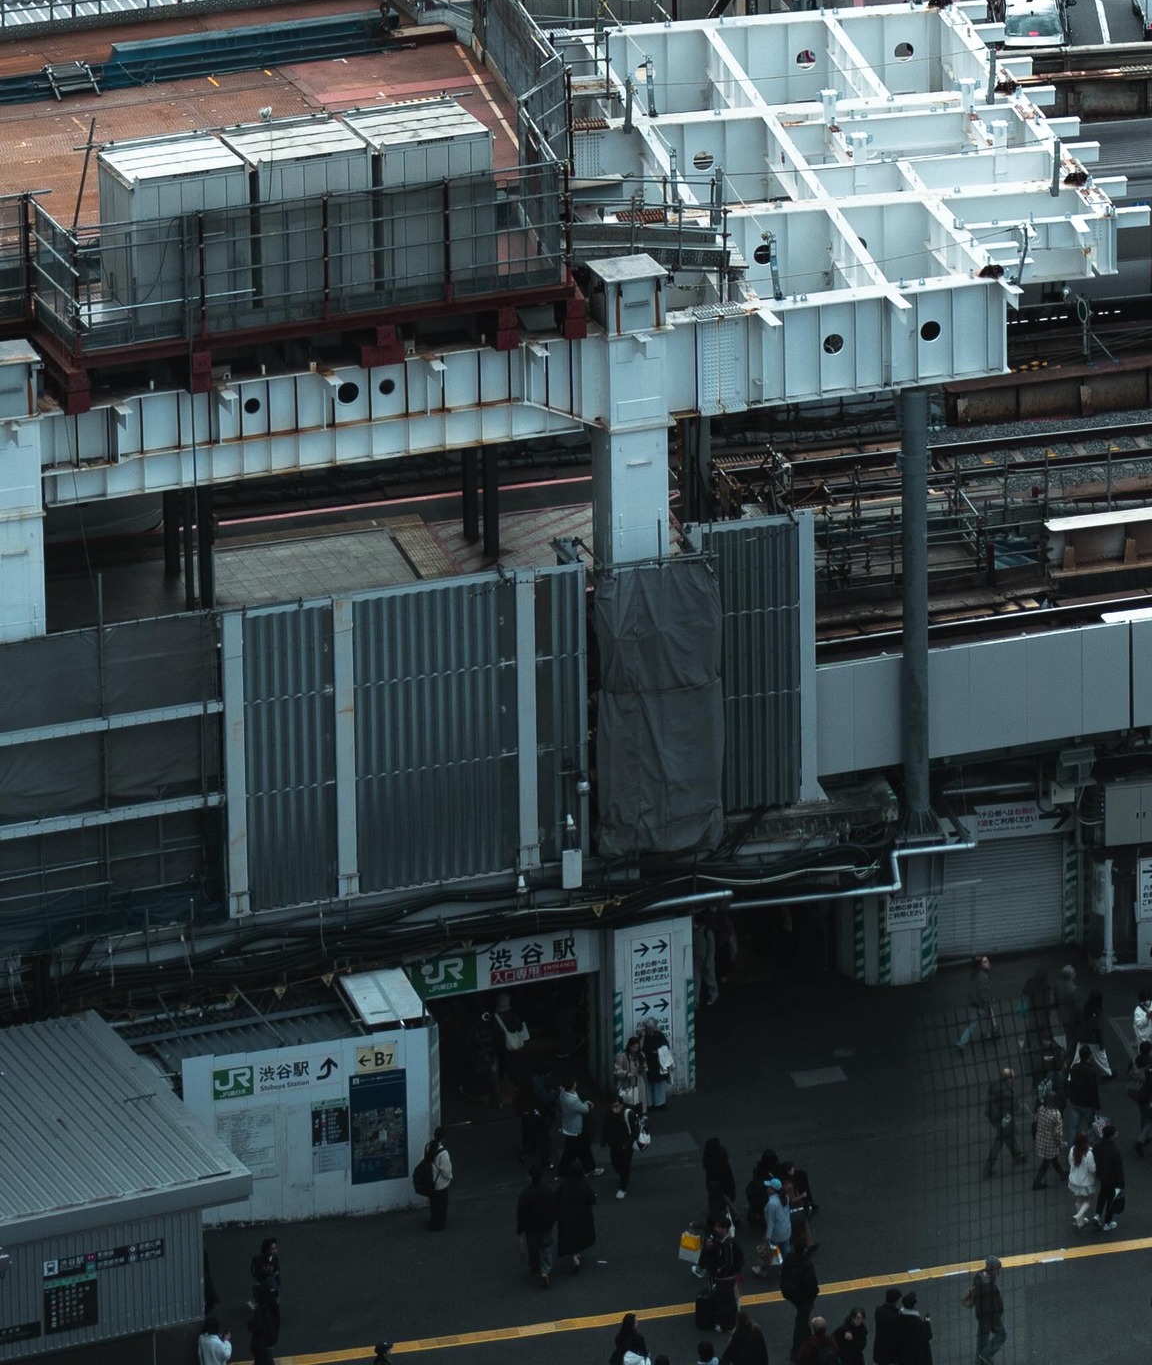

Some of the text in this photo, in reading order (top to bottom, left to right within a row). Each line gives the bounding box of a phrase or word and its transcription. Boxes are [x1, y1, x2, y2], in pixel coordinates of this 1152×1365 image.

[488, 936, 577, 972] 渋谷駅
[490, 966, 541, 986] 入口専用
[374, 1052, 394, 1067] B7
[214, 1067, 252, 1091] JR
[258, 1061, 310, 1084] 渋谷駅
[259, 1078, 311, 1093] Shibuya Station
